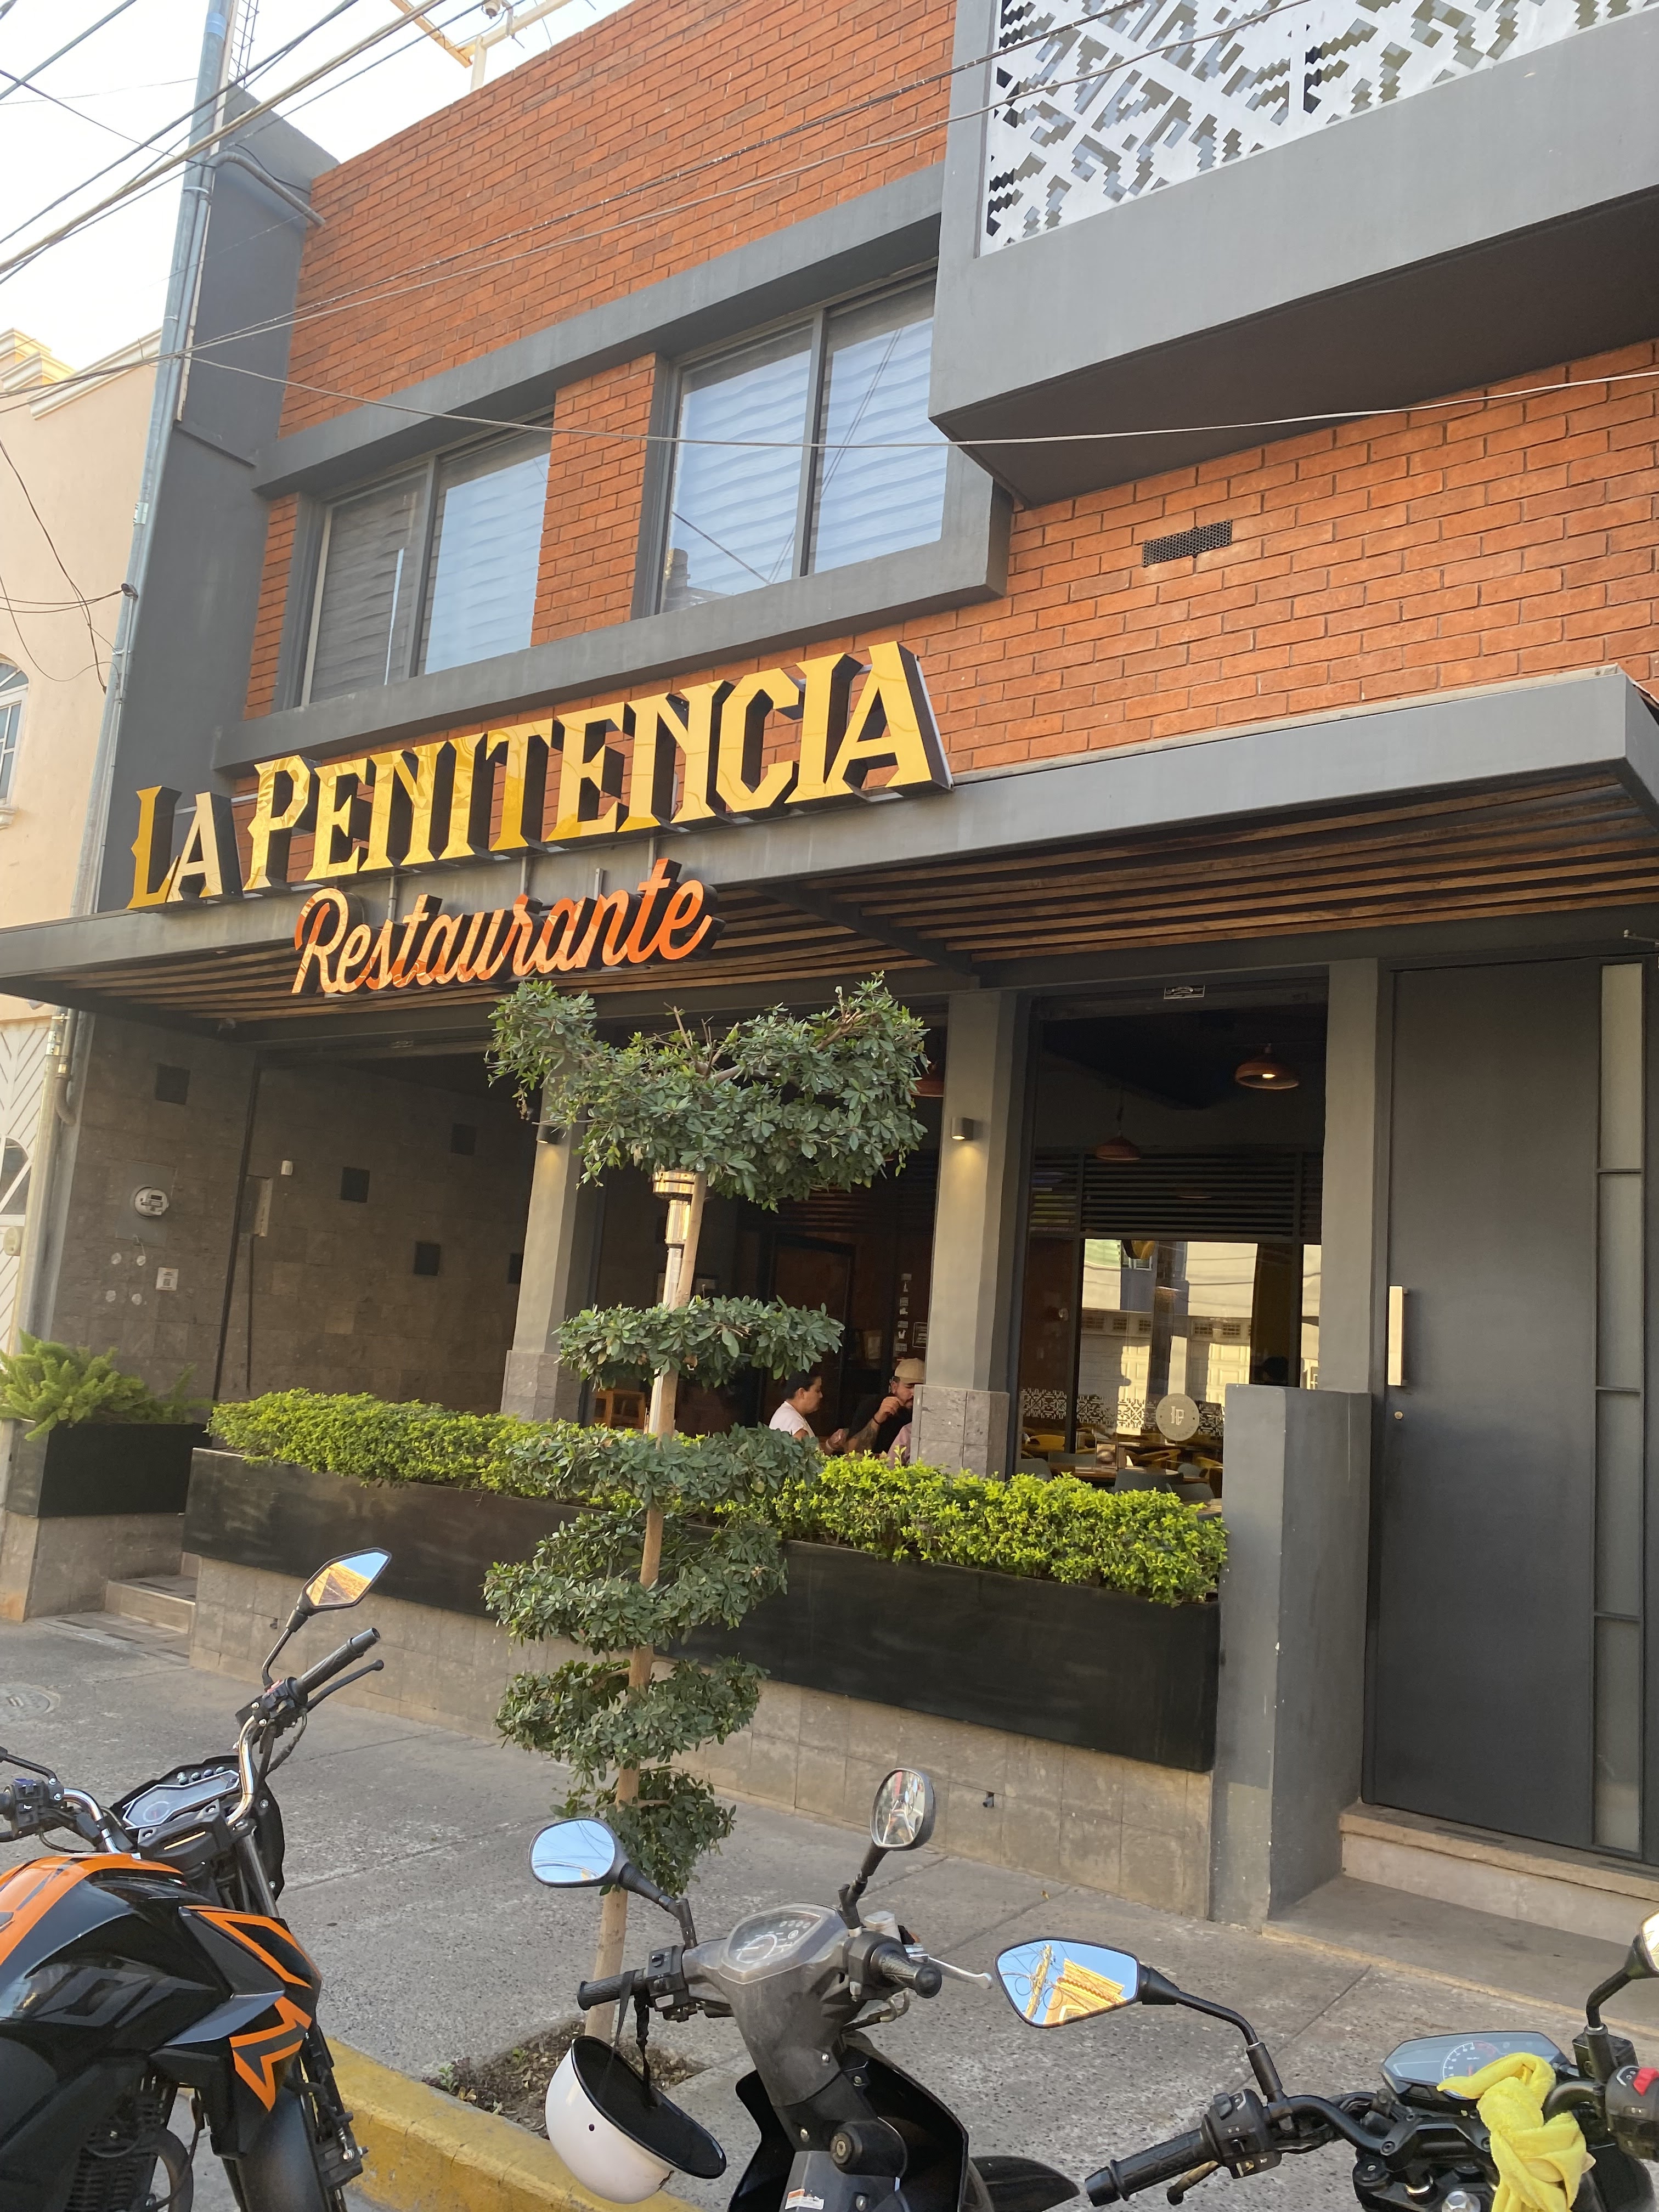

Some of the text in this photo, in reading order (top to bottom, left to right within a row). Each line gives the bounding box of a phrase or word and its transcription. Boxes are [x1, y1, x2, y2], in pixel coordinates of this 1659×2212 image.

[127, 641, 932, 909] LA PENITENCIA
[292, 859, 712, 994] Restaurante
